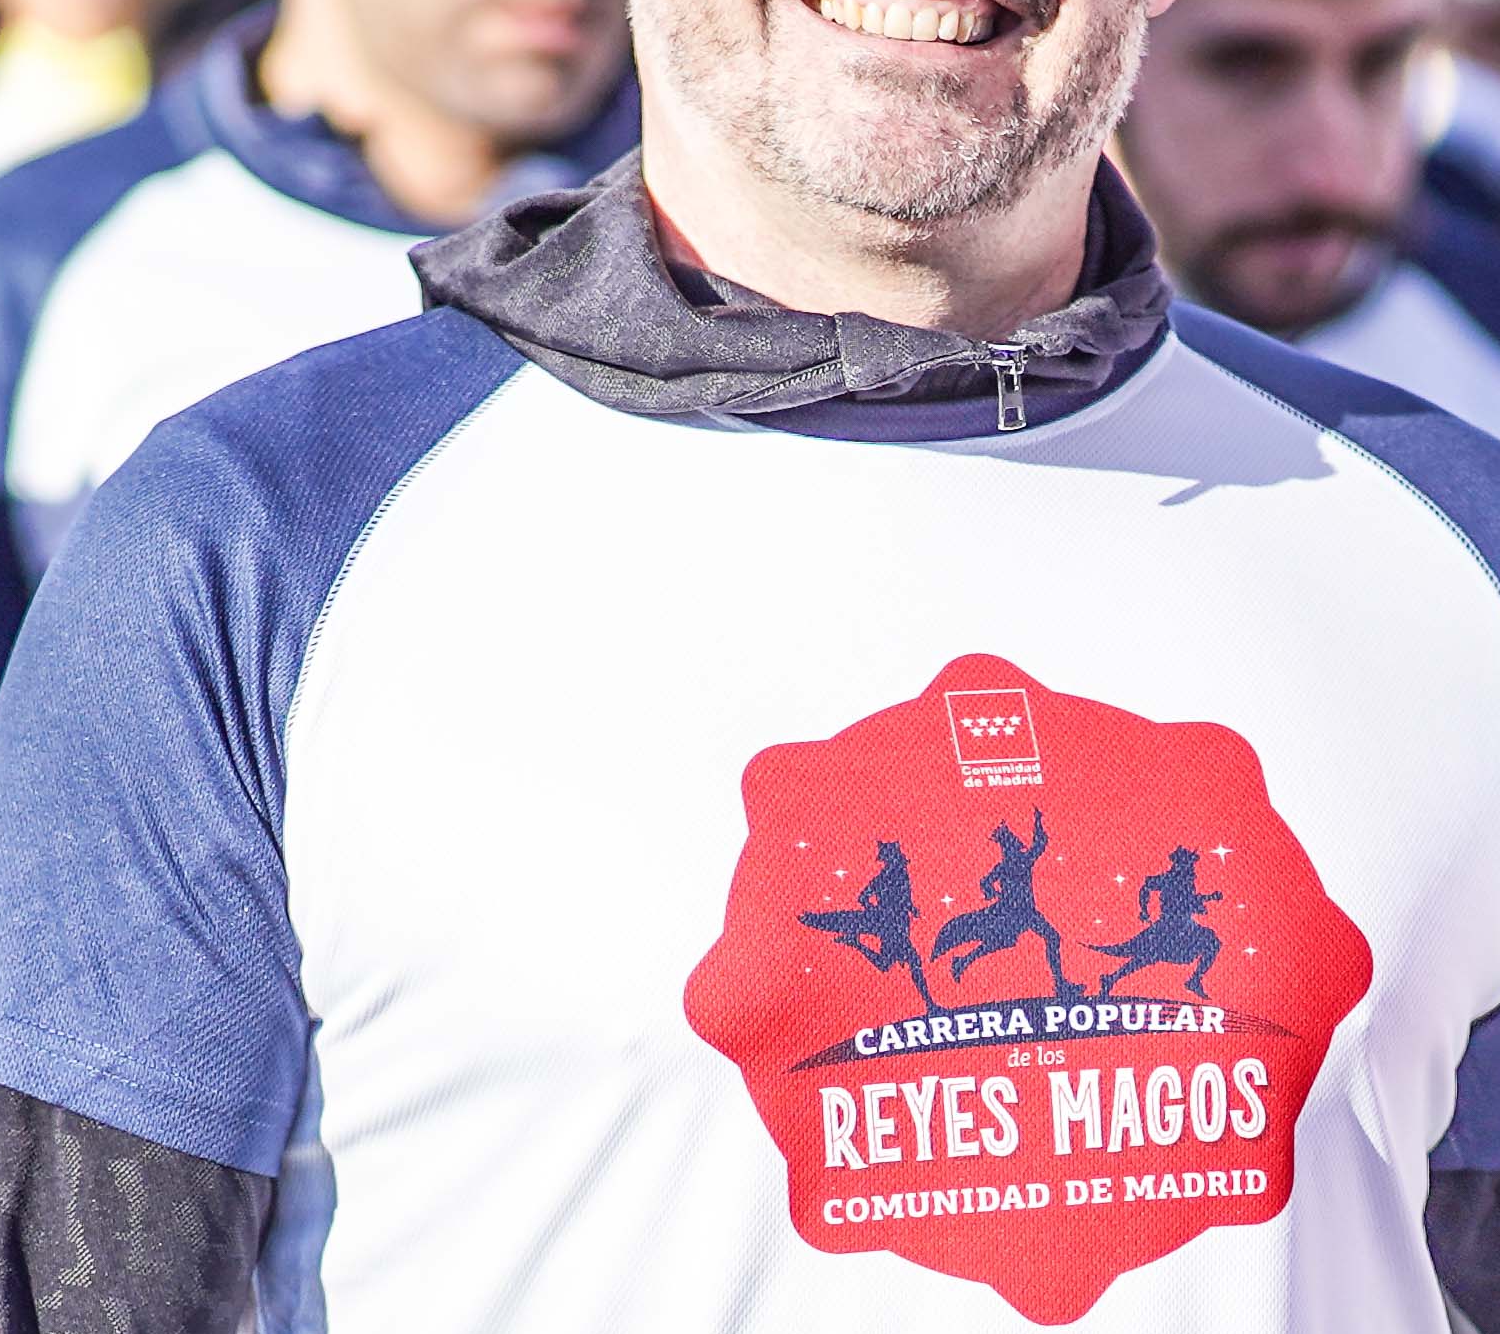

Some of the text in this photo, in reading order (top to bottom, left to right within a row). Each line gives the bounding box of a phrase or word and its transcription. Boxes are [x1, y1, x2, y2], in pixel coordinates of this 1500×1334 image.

[961, 762, 1041, 775] Comunidad
[963, 772, 1043, 788] de Madrid
[855, 1003, 1225, 1055] CARRERA POPULAR
[1007, 1044, 1066, 1068] de los
[819, 1057, 1269, 1170] REYES MAGOS
[822, 1168, 1268, 1225] COMUNIDAD DE MADRID
